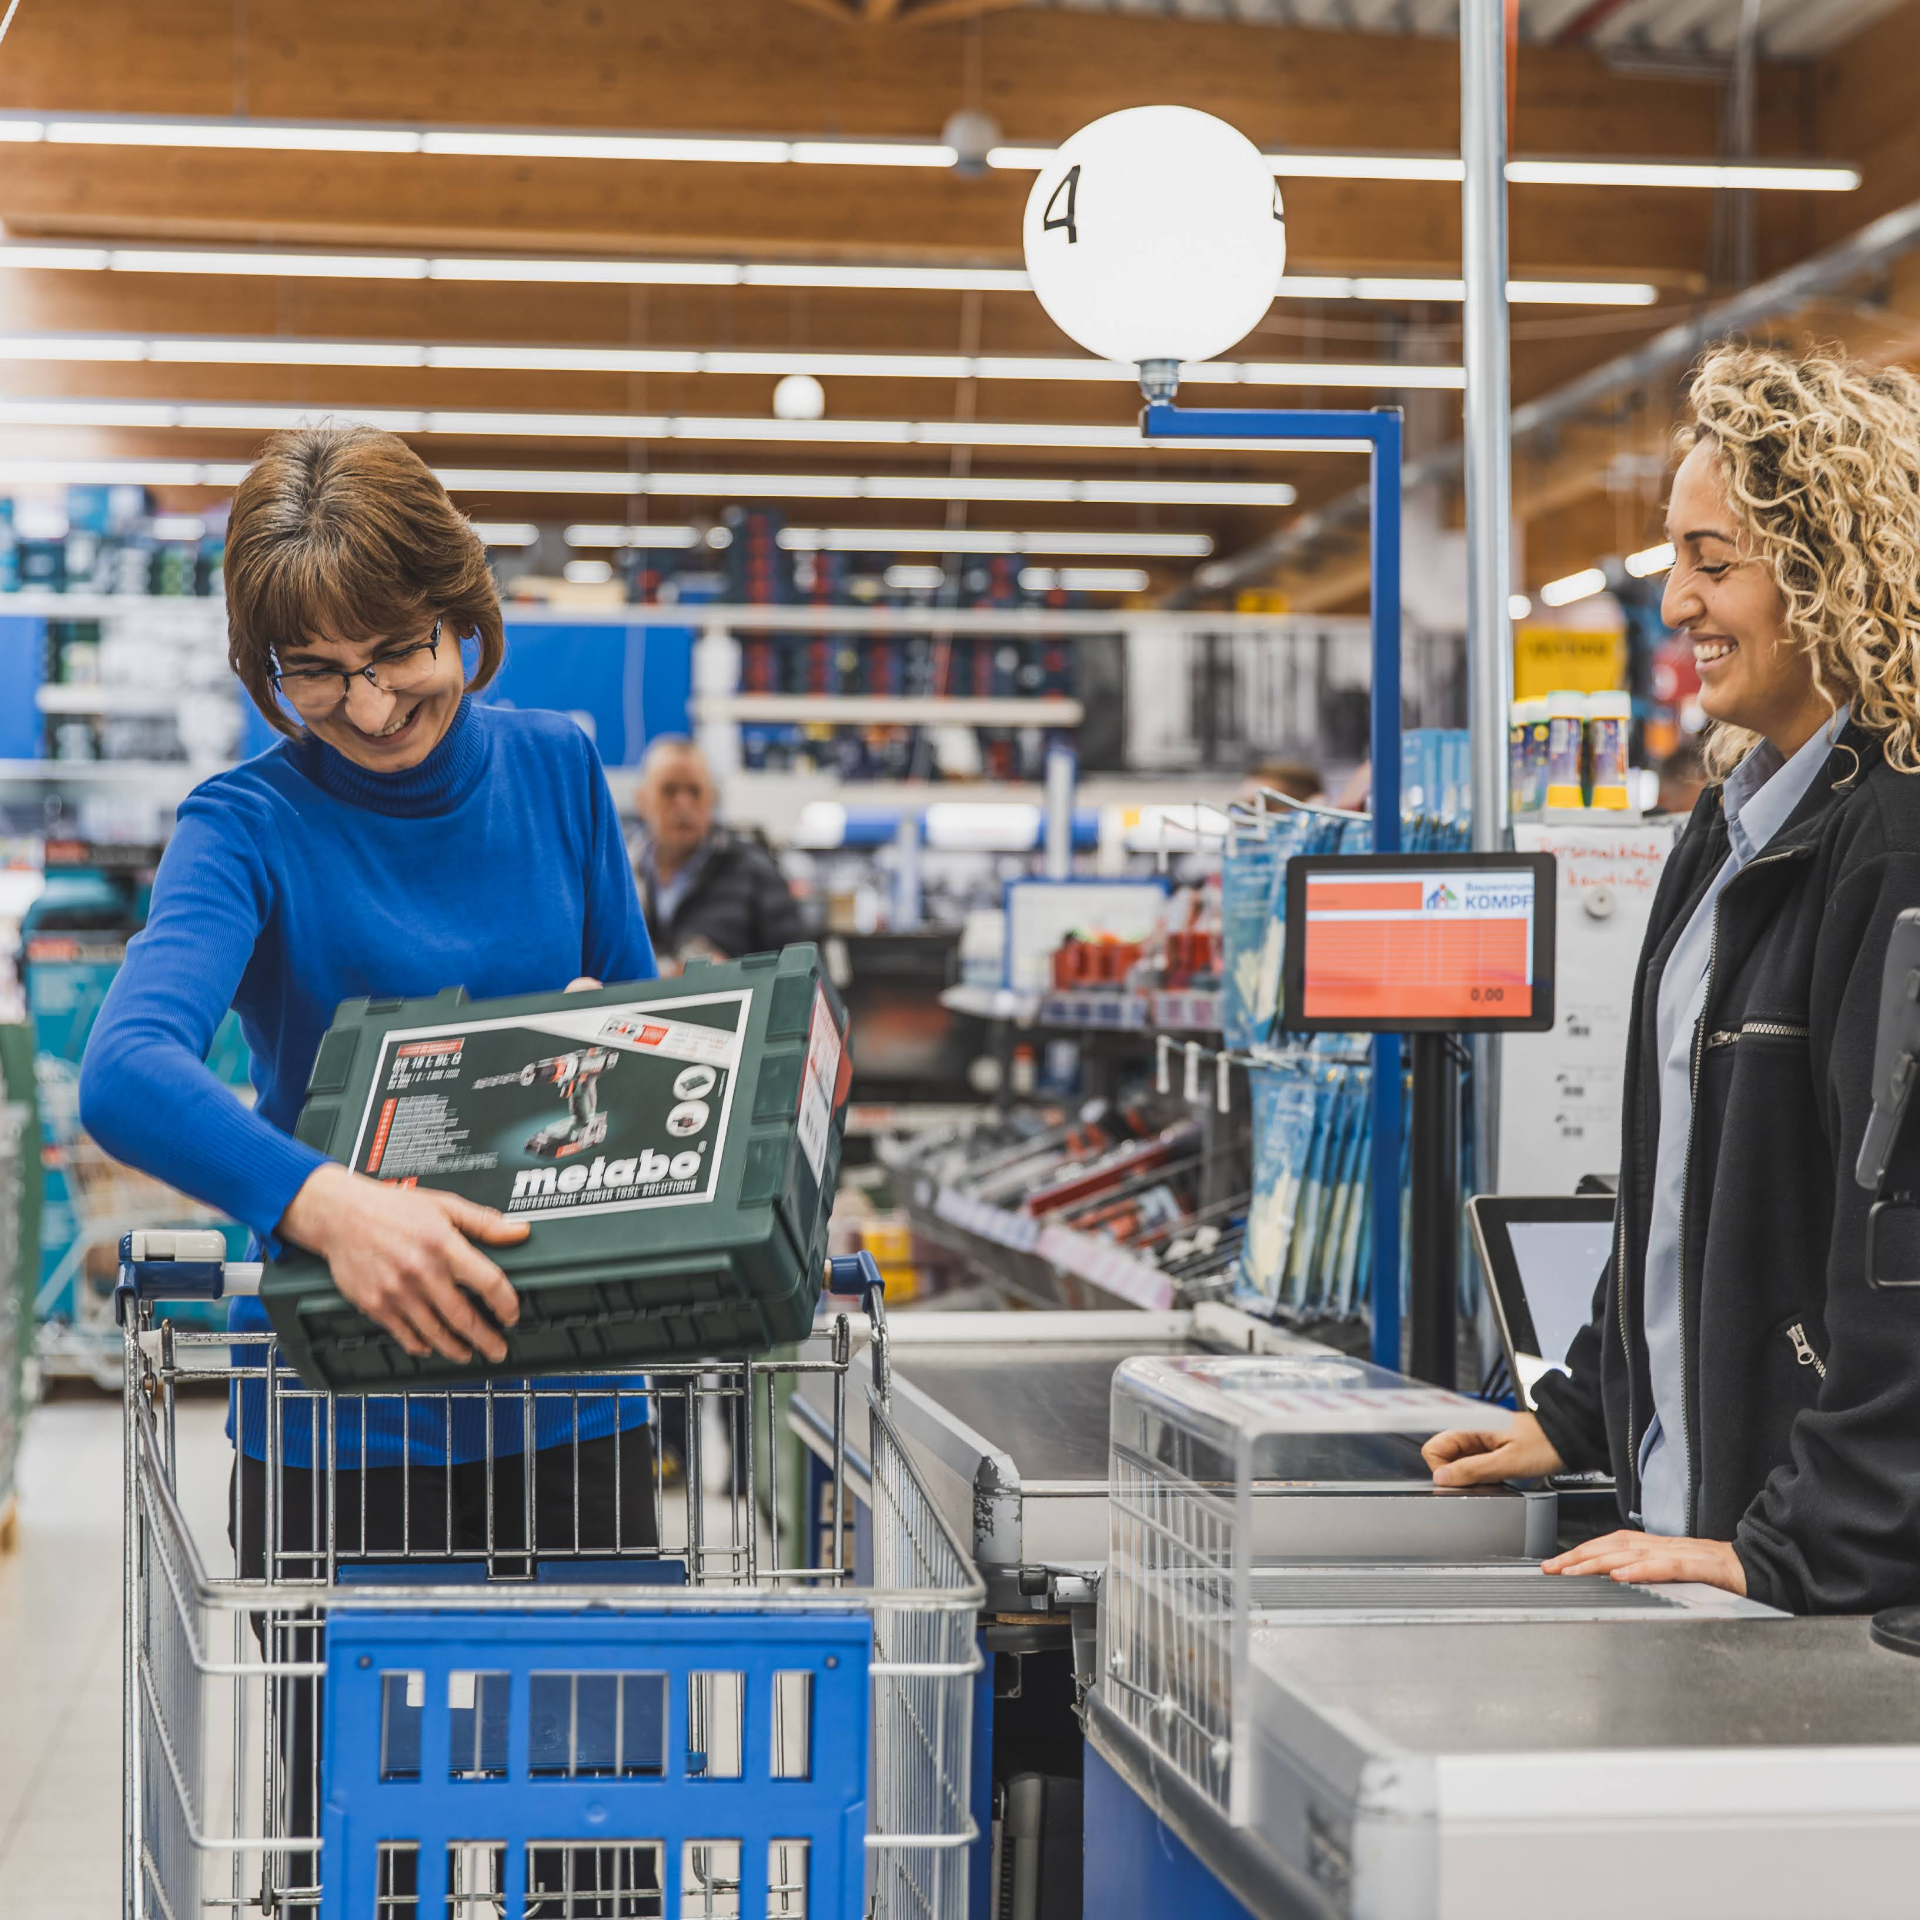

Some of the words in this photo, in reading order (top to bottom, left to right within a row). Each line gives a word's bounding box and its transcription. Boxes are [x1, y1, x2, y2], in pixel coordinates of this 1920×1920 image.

[1043, 164, 1081, 244] 4
[1470, 988, 1504, 1003] 0,00
[511, 1148, 701, 1198] metabo
